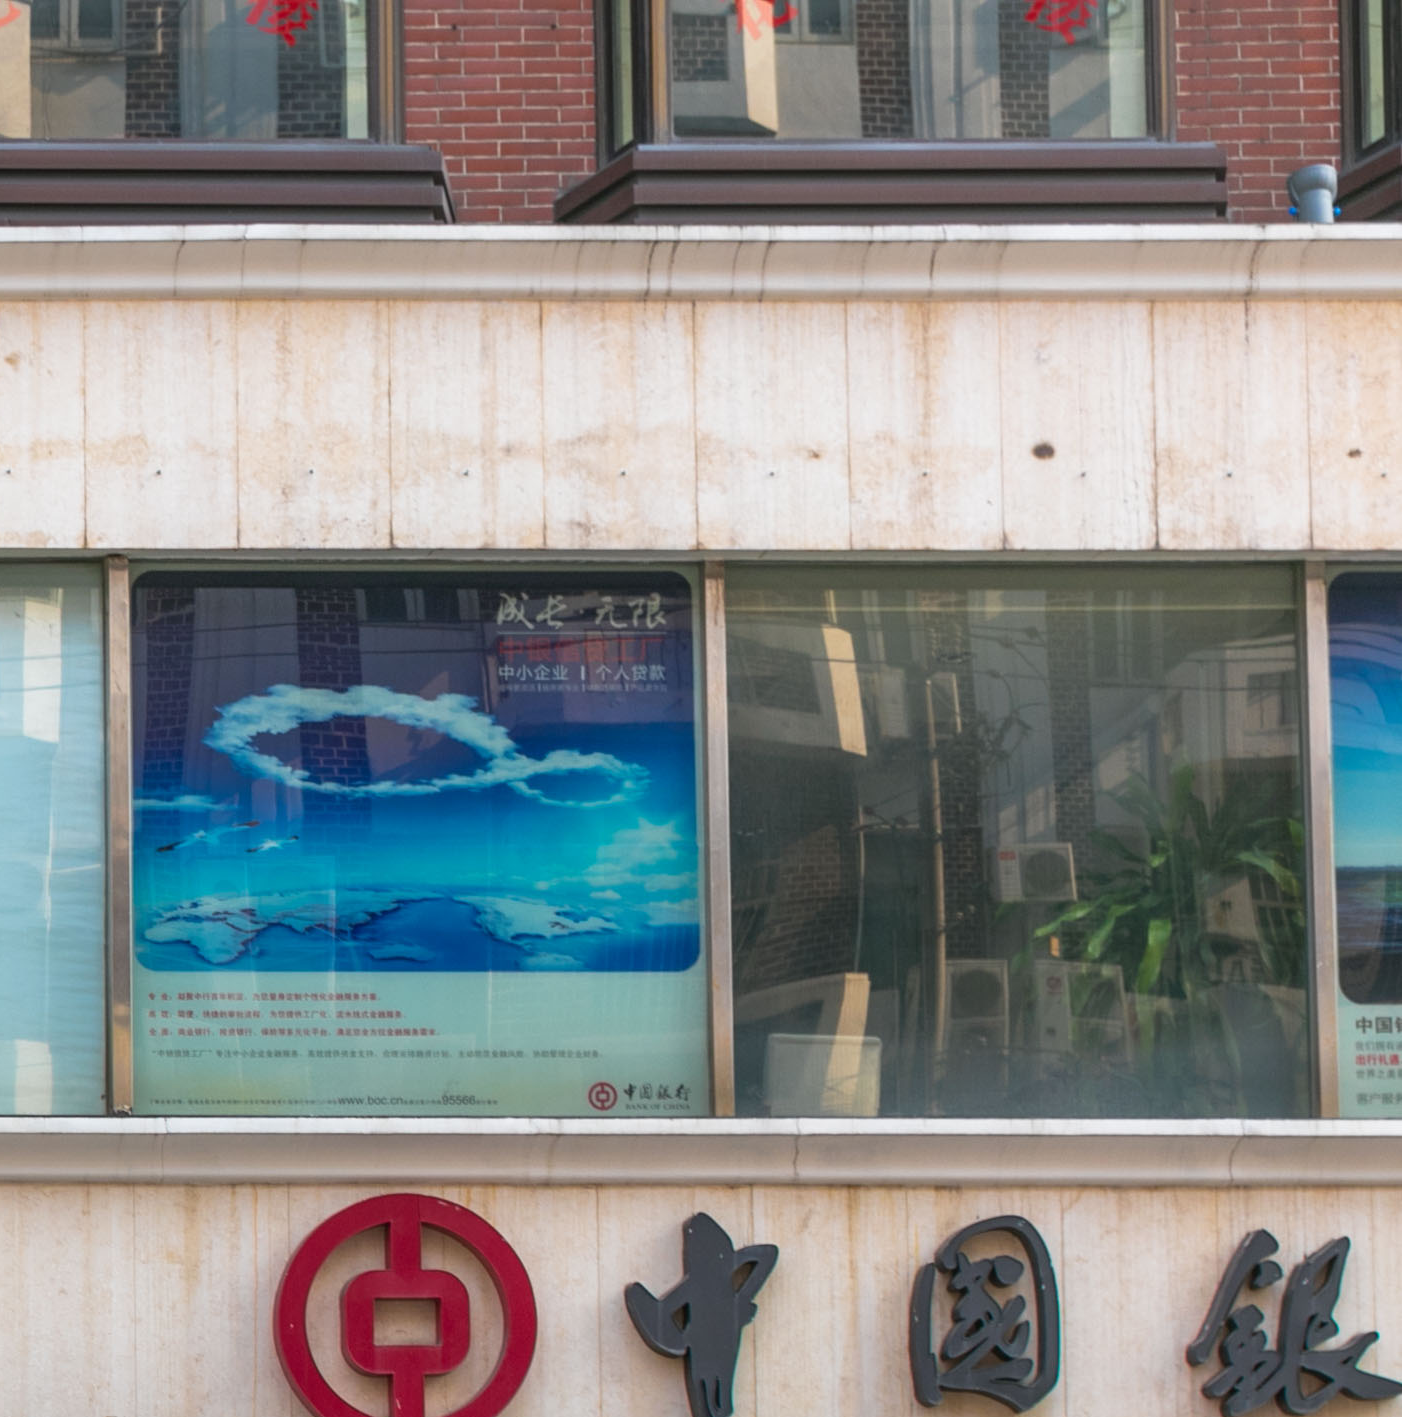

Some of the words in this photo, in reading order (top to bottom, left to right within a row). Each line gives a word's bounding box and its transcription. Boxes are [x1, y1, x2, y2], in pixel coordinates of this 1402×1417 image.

[499, 664, 569, 681] 中小企业
[596, 664, 667, 681] 个人贷款
[338, 1096, 404, 1106] www.boc.cn
